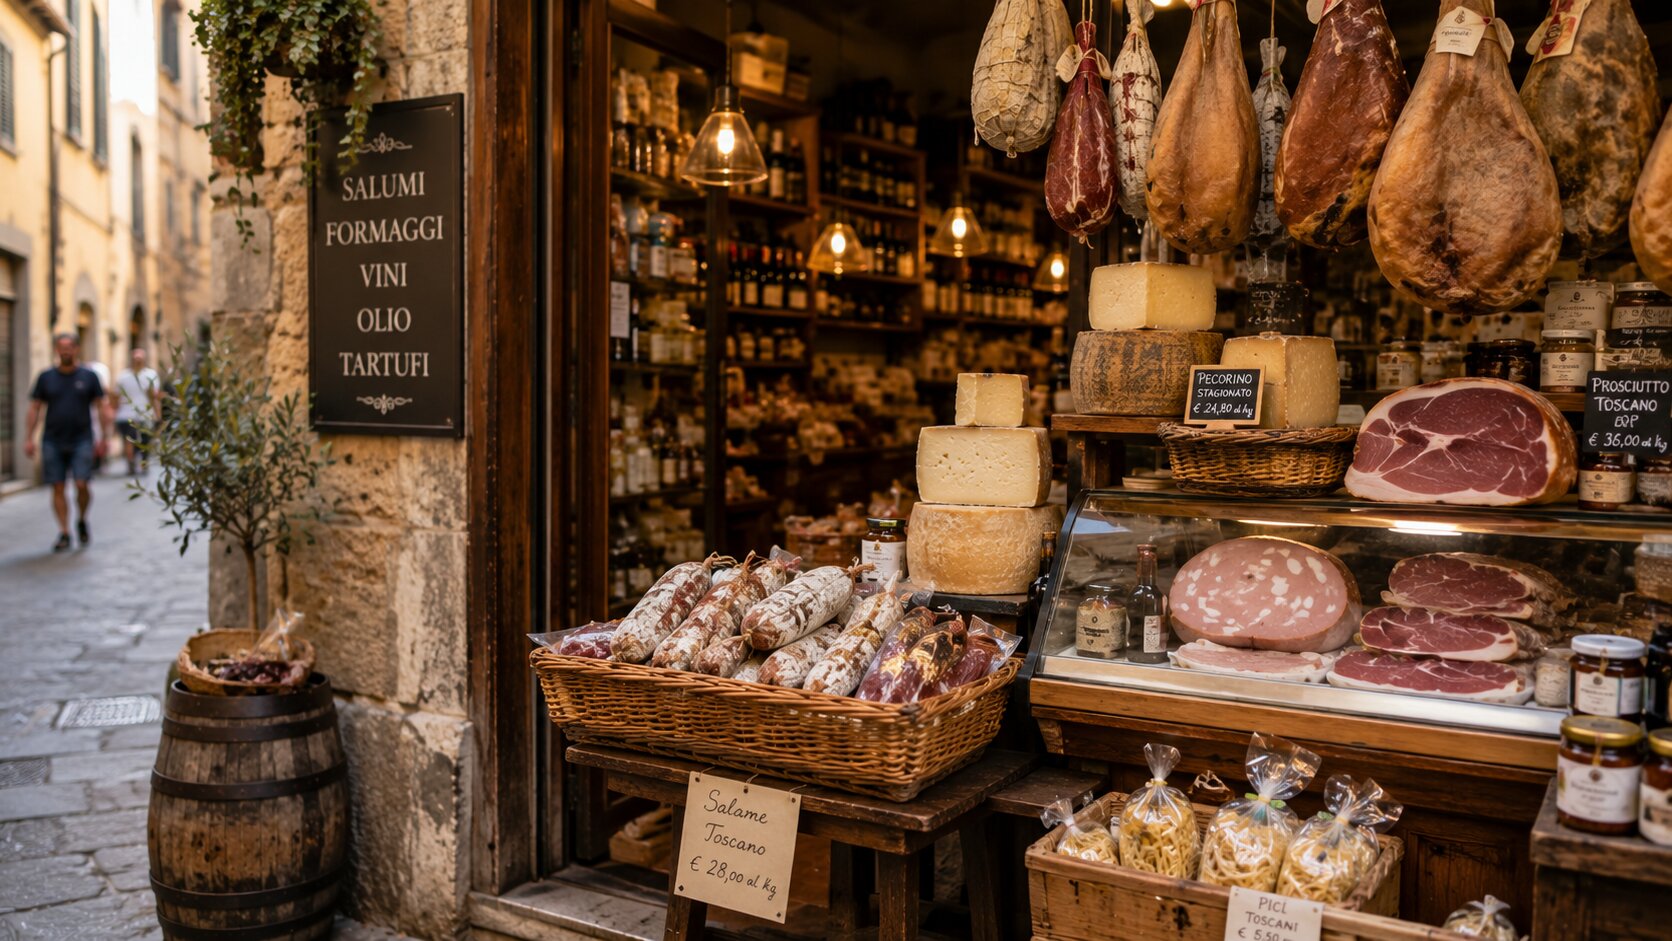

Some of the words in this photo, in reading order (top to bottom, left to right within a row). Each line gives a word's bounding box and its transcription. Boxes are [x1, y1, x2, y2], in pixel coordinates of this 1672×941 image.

[341, 171, 425, 202] SALUMI
[325, 215, 444, 247] FORMAGGI
[359, 262, 408, 288] VINI
[356, 307, 412, 333] OLIO
[338, 351, 430, 378] TARTUFI
[1197, 372, 1253, 385] PECORINO
[1591, 377, 1670, 394] PROSCIUTTO
[1197, 388, 1252, 398] STAGIONATO
[1593, 396, 1658, 412] TOSCANO
[1193, 402, 1201, 414] €
[1588, 432, 1599, 447] €
[1603, 432, 1640, 448] 36,00
[703, 789, 768, 824] Salame
[704, 822, 766, 856] Toscano
[690, 856, 702, 872] €
[706, 859, 744, 884] 28,00
[746, 875, 760, 888] al
[1238, 927, 1247, 939] €
[1245, 911, 1299, 933] TOSCANI
